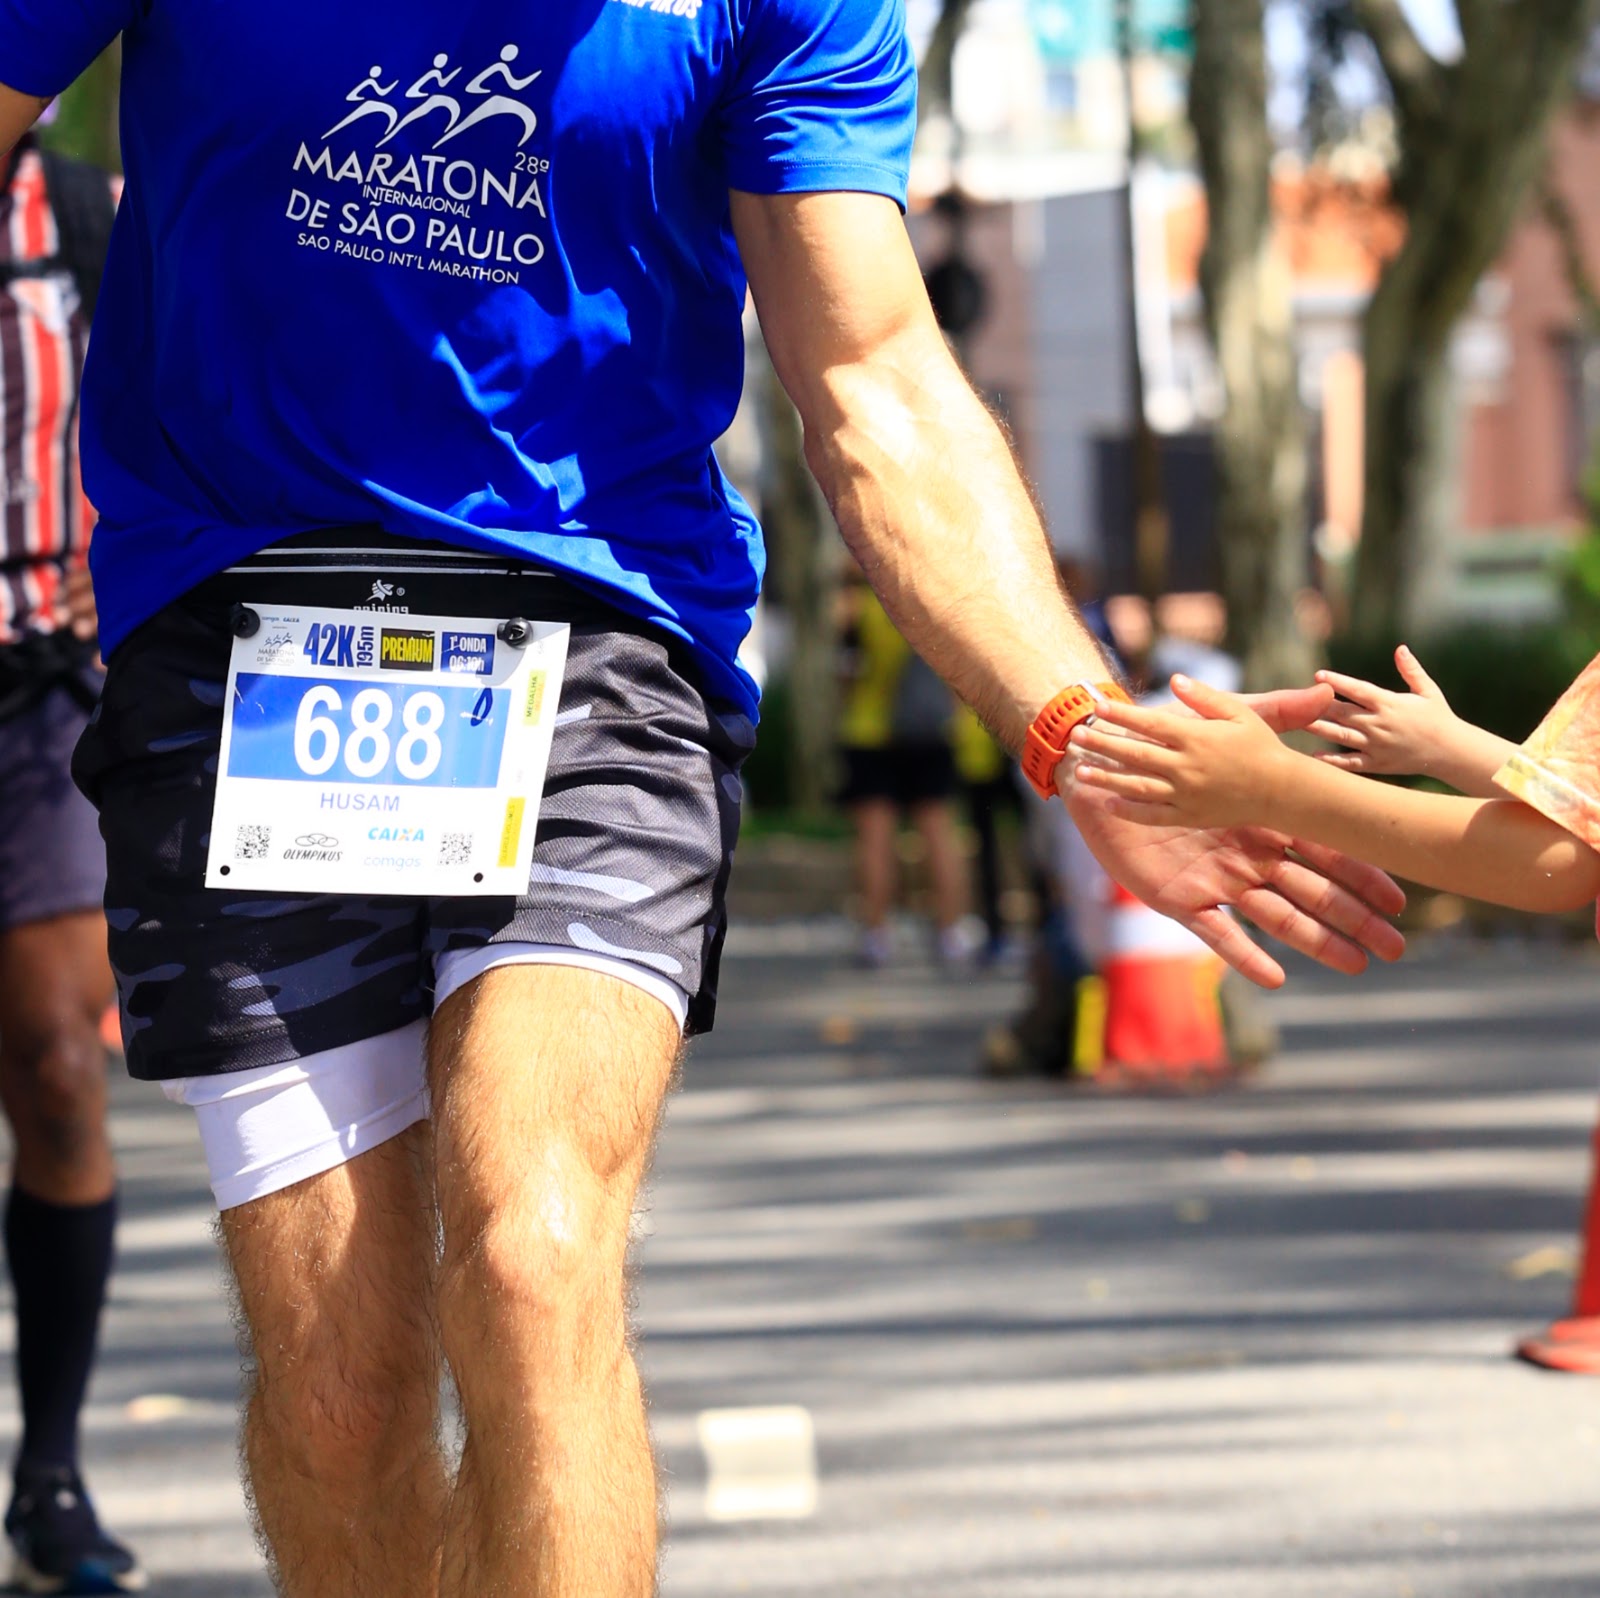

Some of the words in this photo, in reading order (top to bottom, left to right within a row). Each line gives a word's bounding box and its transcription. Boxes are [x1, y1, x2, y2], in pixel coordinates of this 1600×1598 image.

[292, 141, 547, 218] MARATONA
[362, 185, 471, 219] INTERNACIONAL
[285, 189, 331, 228] DE
[339, 200, 416, 245] SÃO
[426, 218, 545, 265] PAULO
[297, 232, 331, 251] SAO
[334, 240, 385, 263] PAULO
[388, 251, 425, 270] INT'L
[428, 259, 519, 284] MARATHON
[303, 622, 356, 668] 42K
[356, 626, 375, 668] 195m
[381, 635, 433, 664] PREMIUM
[458, 637, 487, 654] ONDA
[294, 684, 445, 780] 688
[320, 792, 400, 811] HUSAM
[368, 827, 425, 842] CAIXA
[282, 848, 343, 862] OLYMPIKUS
